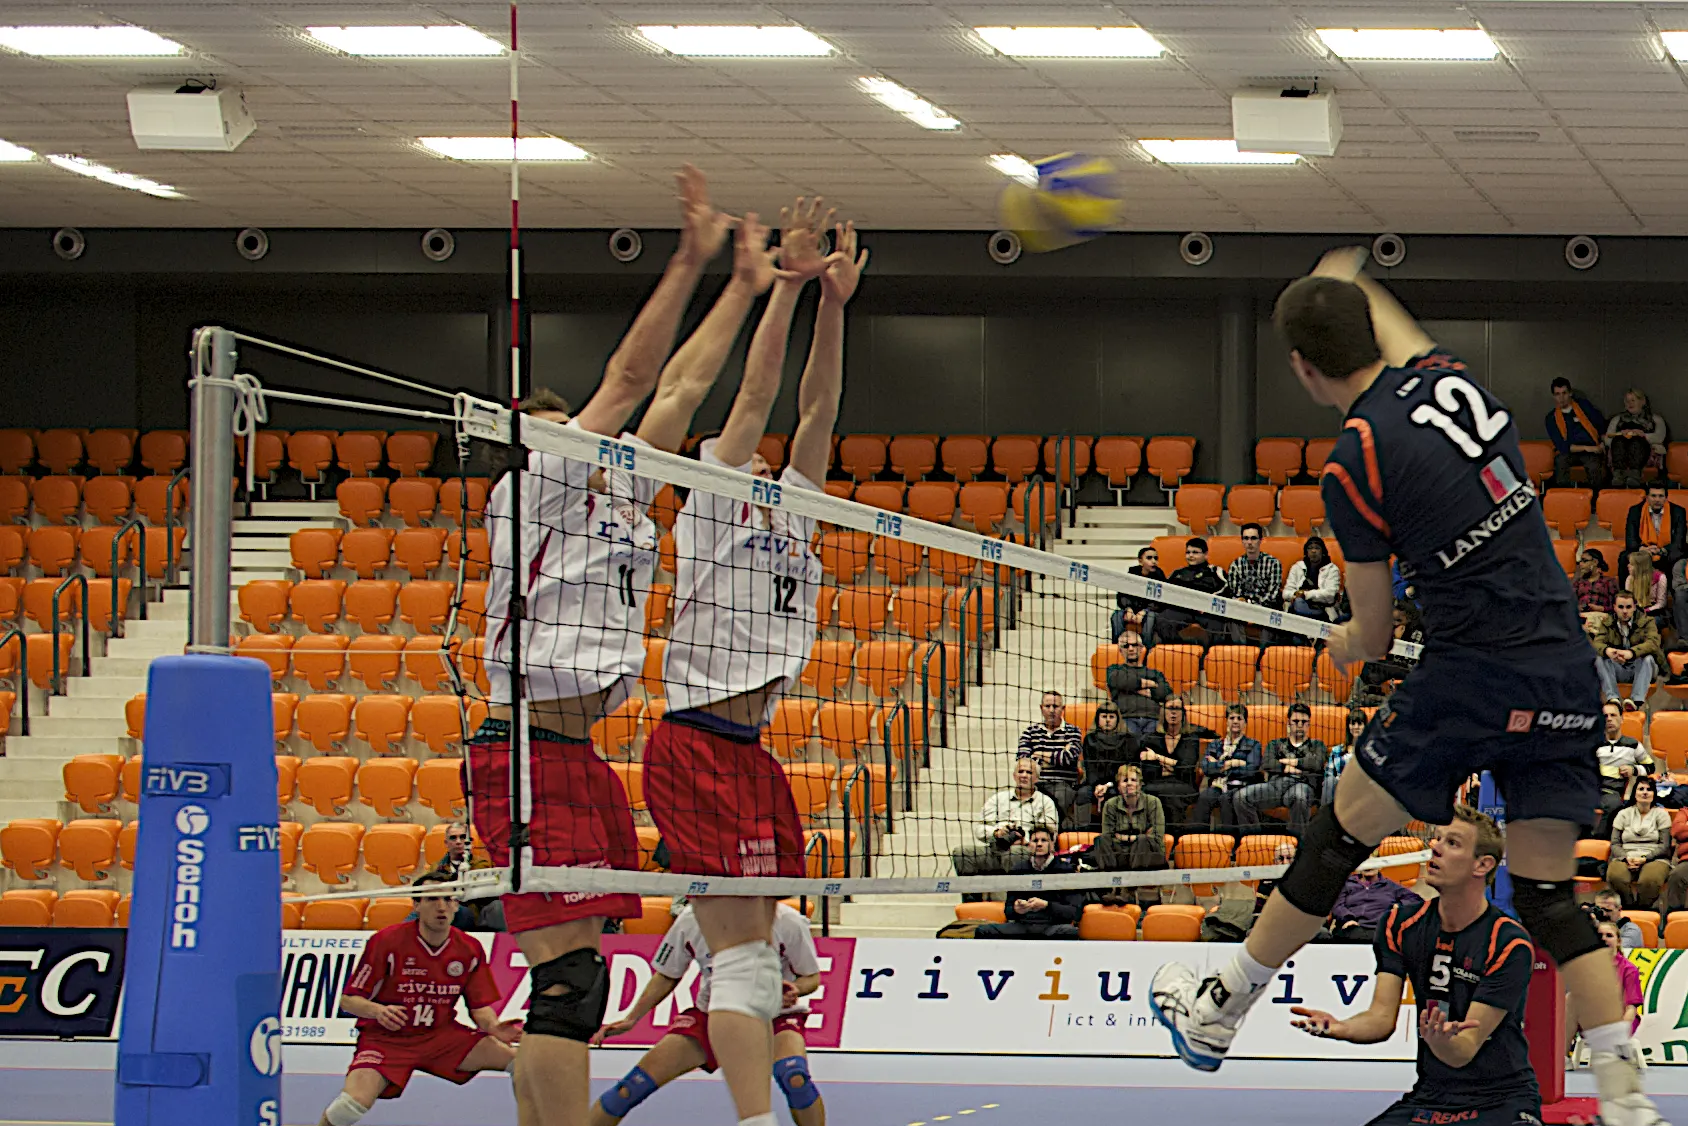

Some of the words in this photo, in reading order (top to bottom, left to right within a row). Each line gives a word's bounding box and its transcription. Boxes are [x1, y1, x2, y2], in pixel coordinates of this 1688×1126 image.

[1411, 376, 1509, 458] 12
[619, 564, 636, 607] 11
[774, 574, 797, 613] 12
[397, 980, 461, 995] rivium
[856, 956, 1132, 1001] riviu
[1429, 954, 1452, 987] 5
[413, 1004, 434, 1026] 14
[1067, 1012, 1094, 1026] ict
[1105, 1012, 1117, 1027] &
[1128, 1012, 1160, 1027] inf
